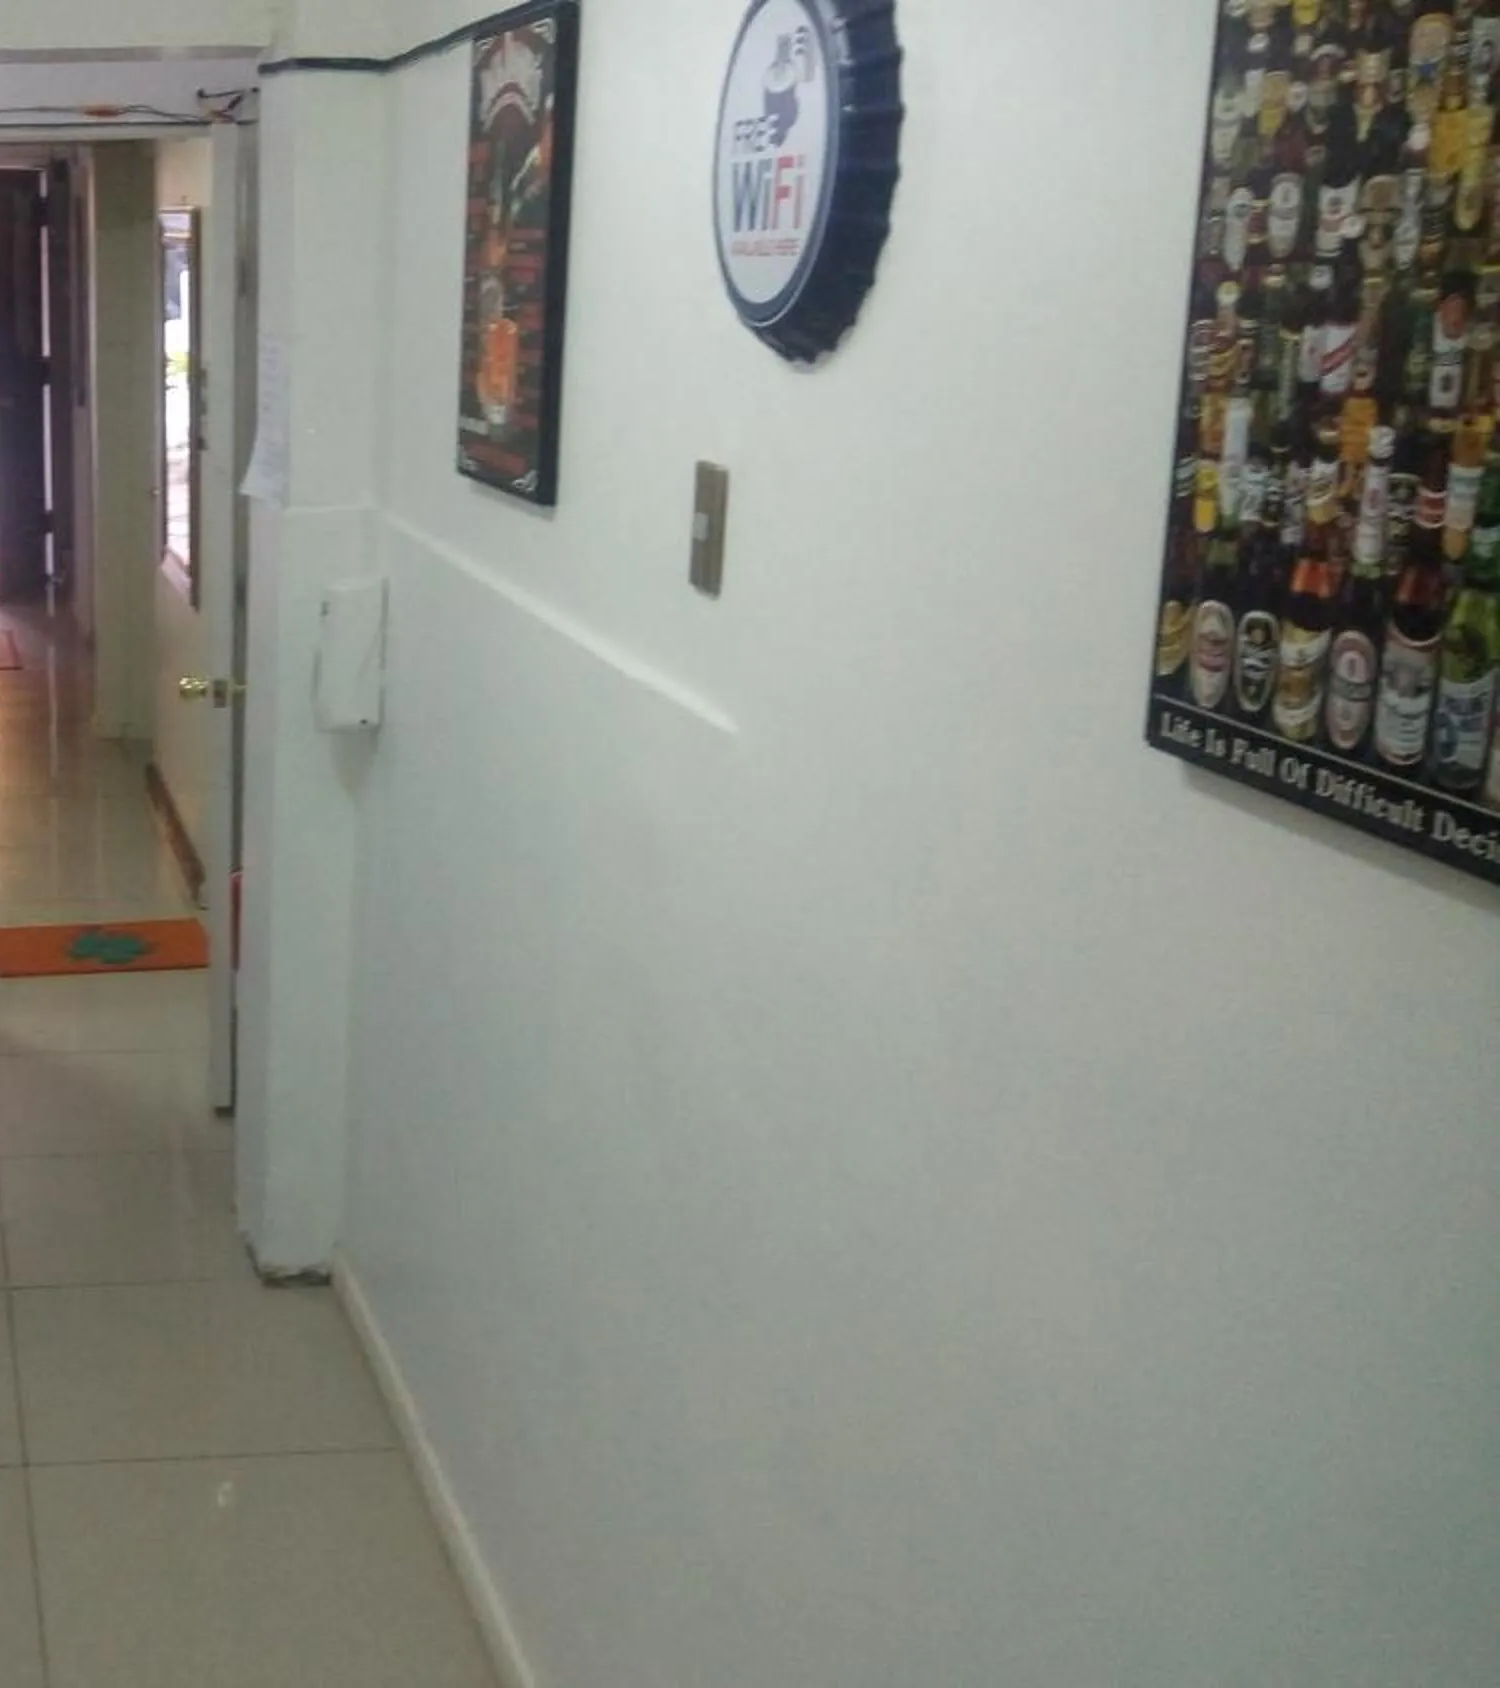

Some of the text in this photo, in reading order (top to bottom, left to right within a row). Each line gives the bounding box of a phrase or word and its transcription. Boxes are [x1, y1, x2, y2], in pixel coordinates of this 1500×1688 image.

[731, 154, 806, 232] WiFi
[1160, 712, 1500, 863] Life Is Full Of Difficult Deci
